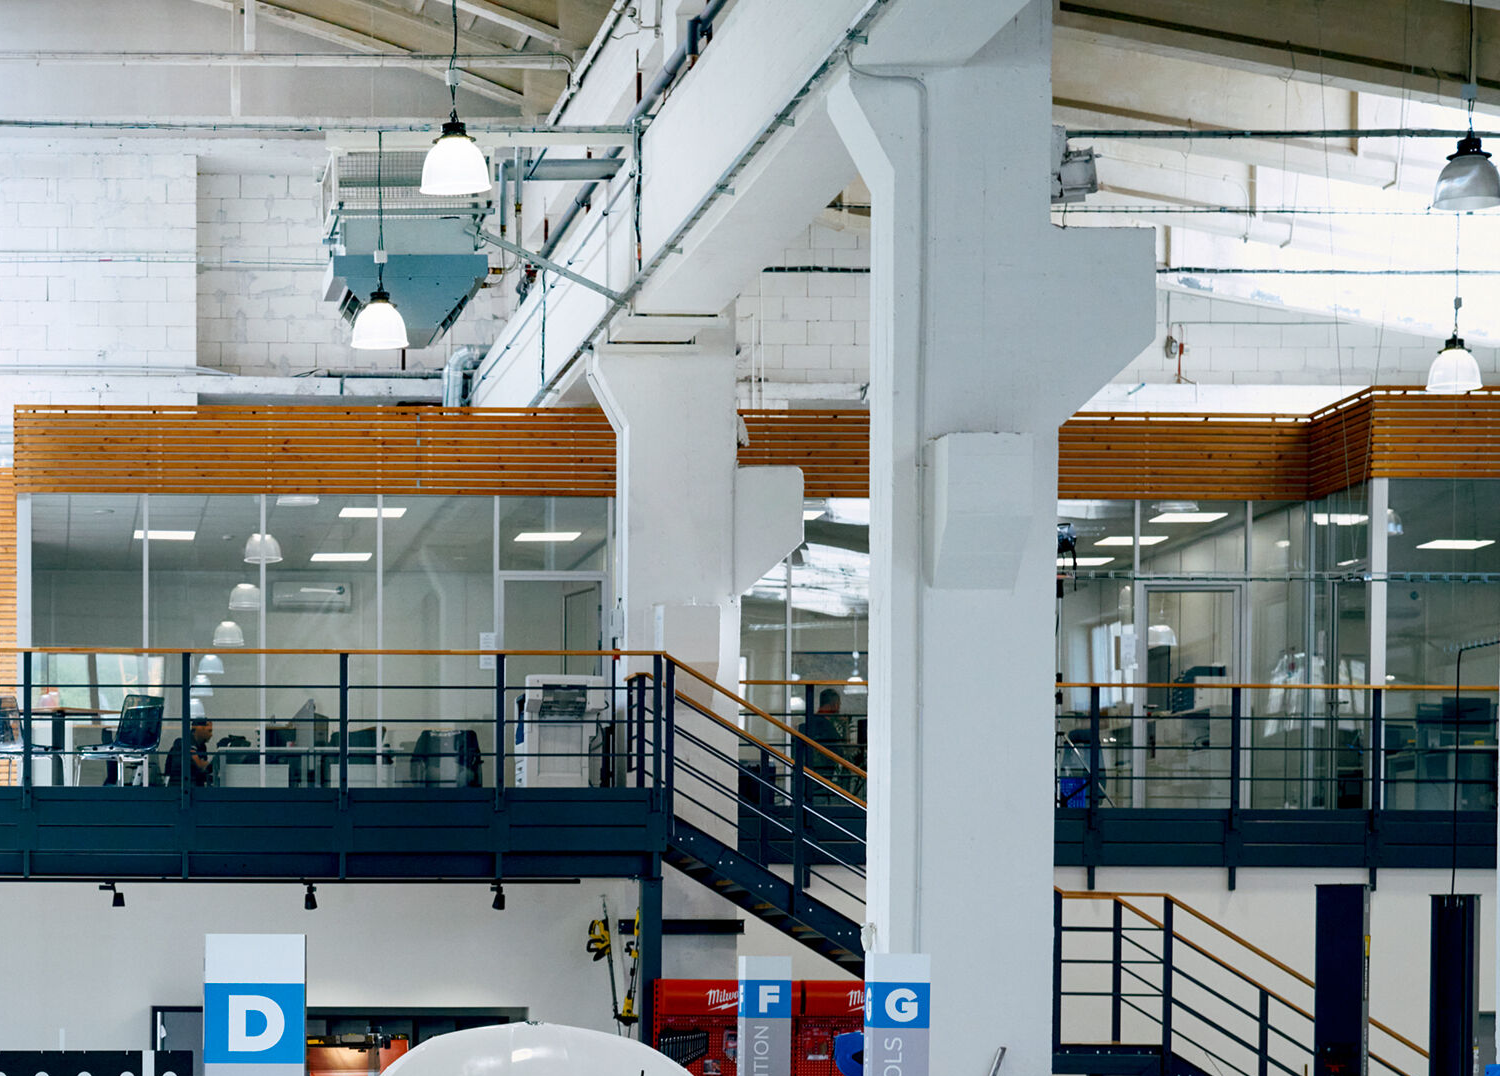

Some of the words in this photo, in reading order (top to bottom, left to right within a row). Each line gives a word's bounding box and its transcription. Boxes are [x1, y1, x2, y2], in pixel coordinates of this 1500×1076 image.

[759, 985, 780, 1013] F
[885, 988, 918, 1022] G
[228, 995, 285, 1051] D
